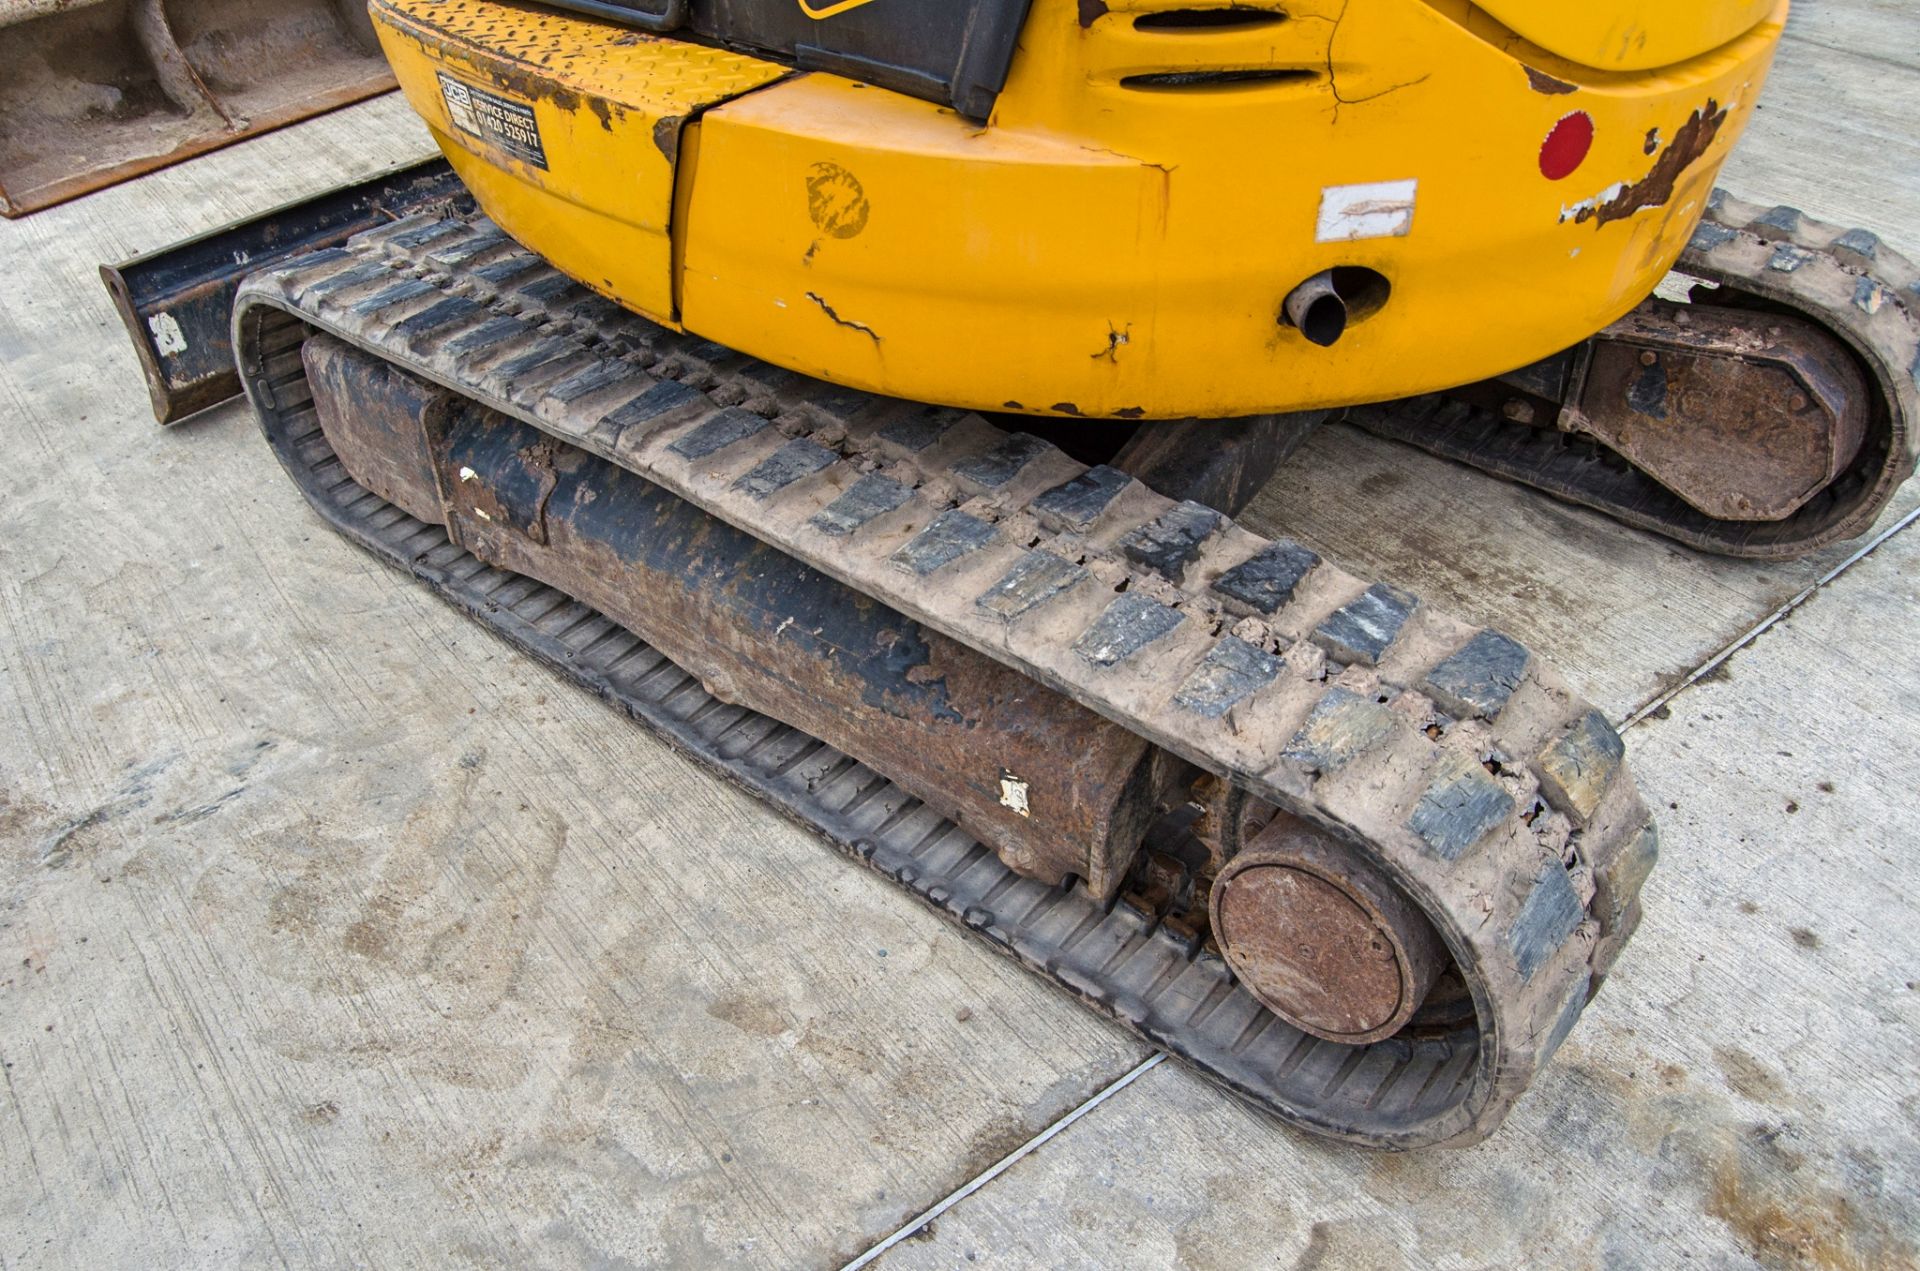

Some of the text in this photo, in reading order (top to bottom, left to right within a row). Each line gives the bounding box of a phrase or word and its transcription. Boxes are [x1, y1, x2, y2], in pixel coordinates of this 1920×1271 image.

[443, 81, 470, 106] JCB
[475, 110, 538, 147] 01420 525917
[503, 109, 535, 132] DIRECT
